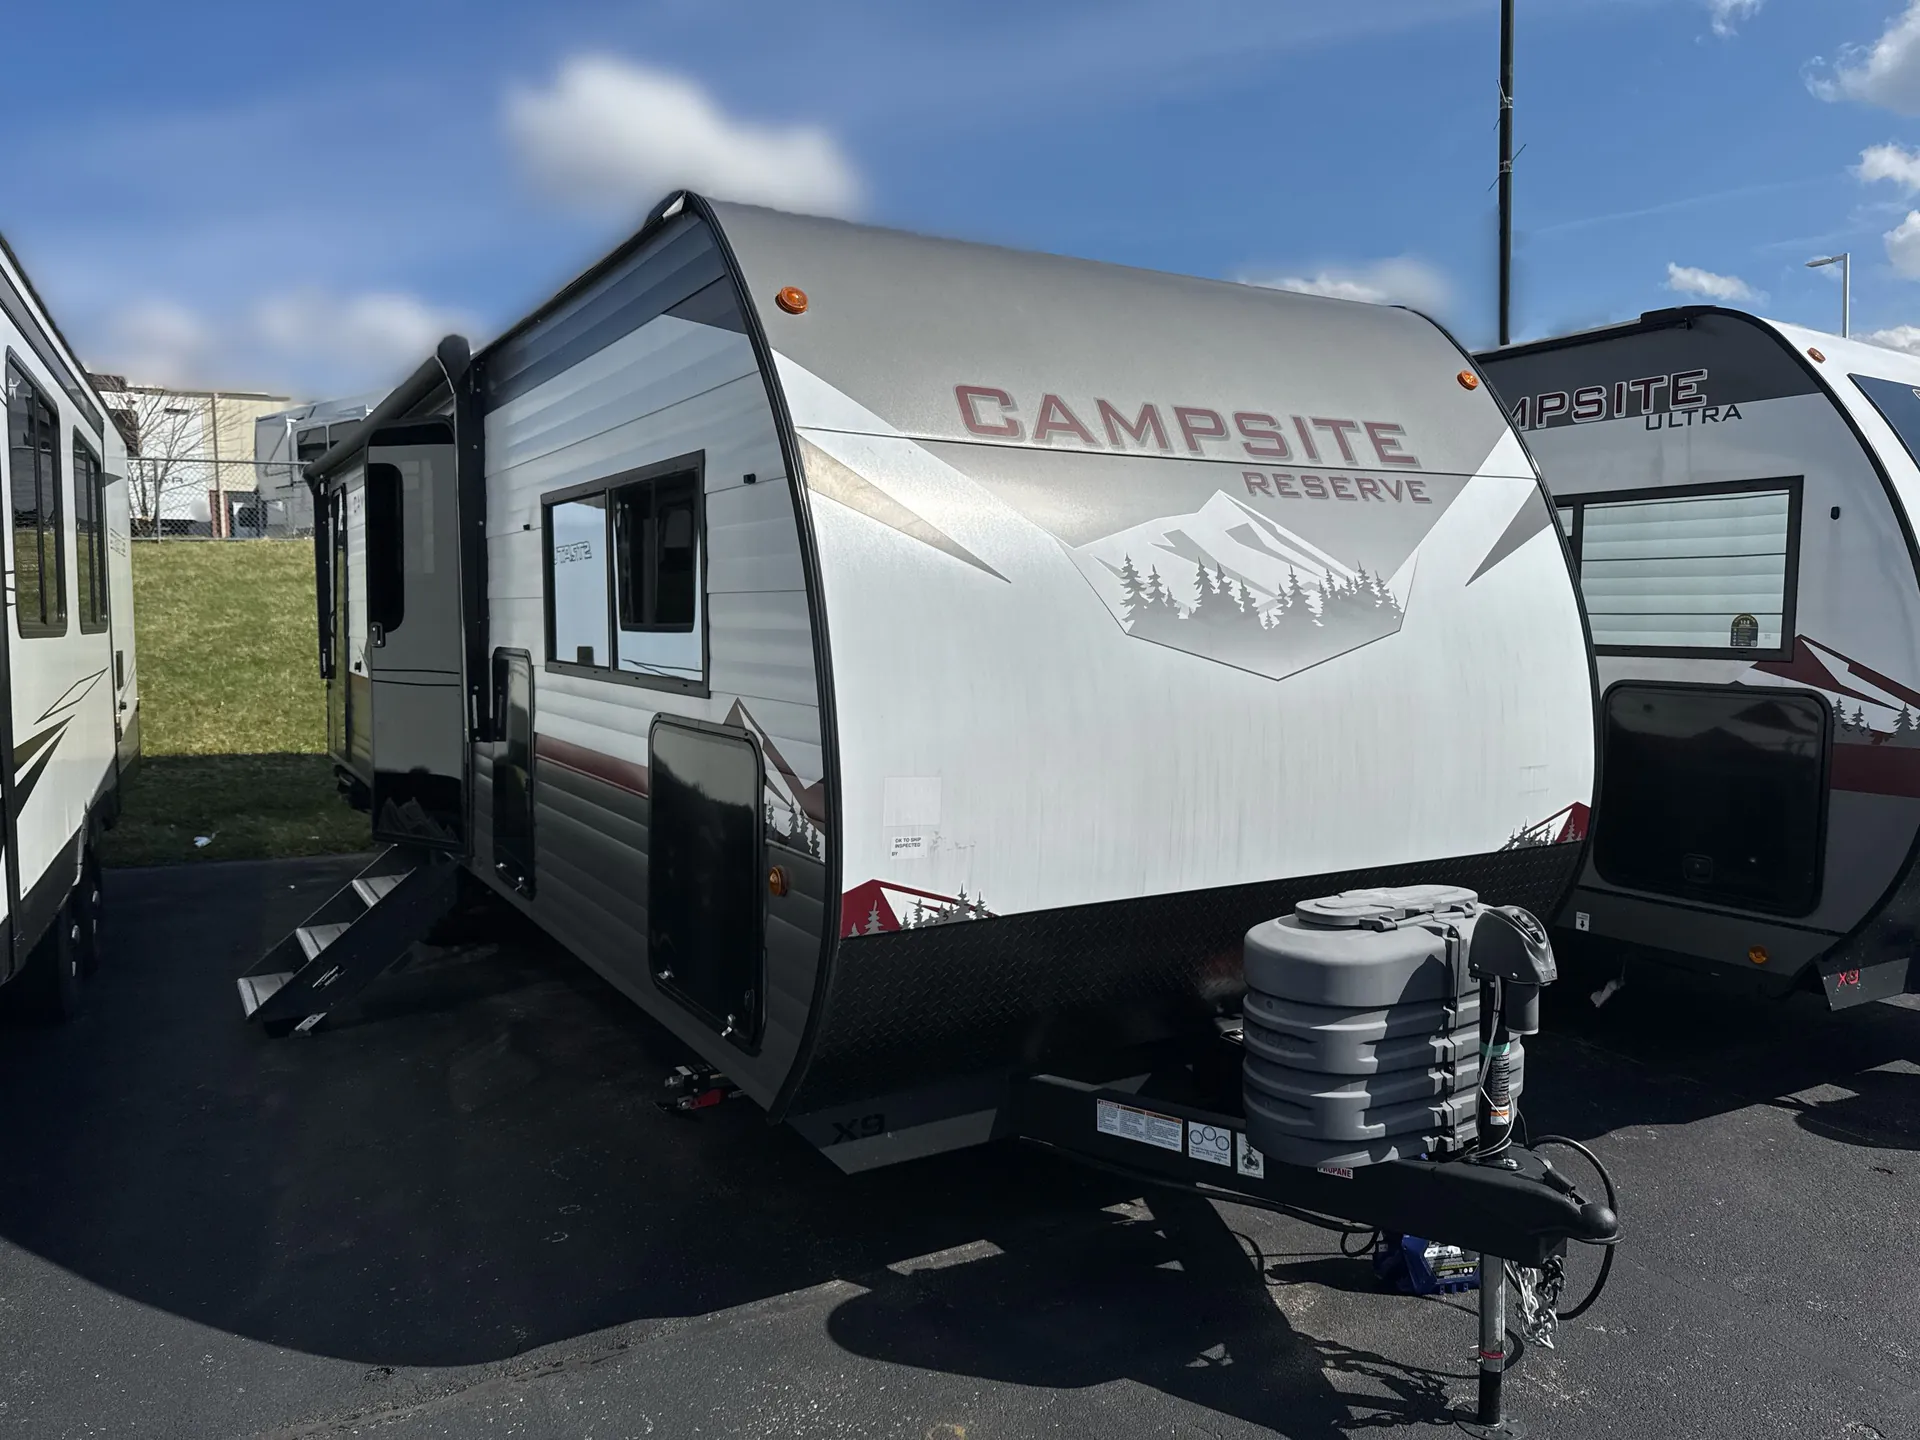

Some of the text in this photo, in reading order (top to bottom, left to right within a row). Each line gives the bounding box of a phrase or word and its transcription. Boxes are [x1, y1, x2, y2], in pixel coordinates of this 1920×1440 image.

[953, 383, 1421, 469] CAMPSITE
[1645, 404, 1742, 431] ULTRA
[1241, 471, 1432, 503] RESERVE
[1837, 968, 1860, 988] X9
[832, 1113, 886, 1146] X9
